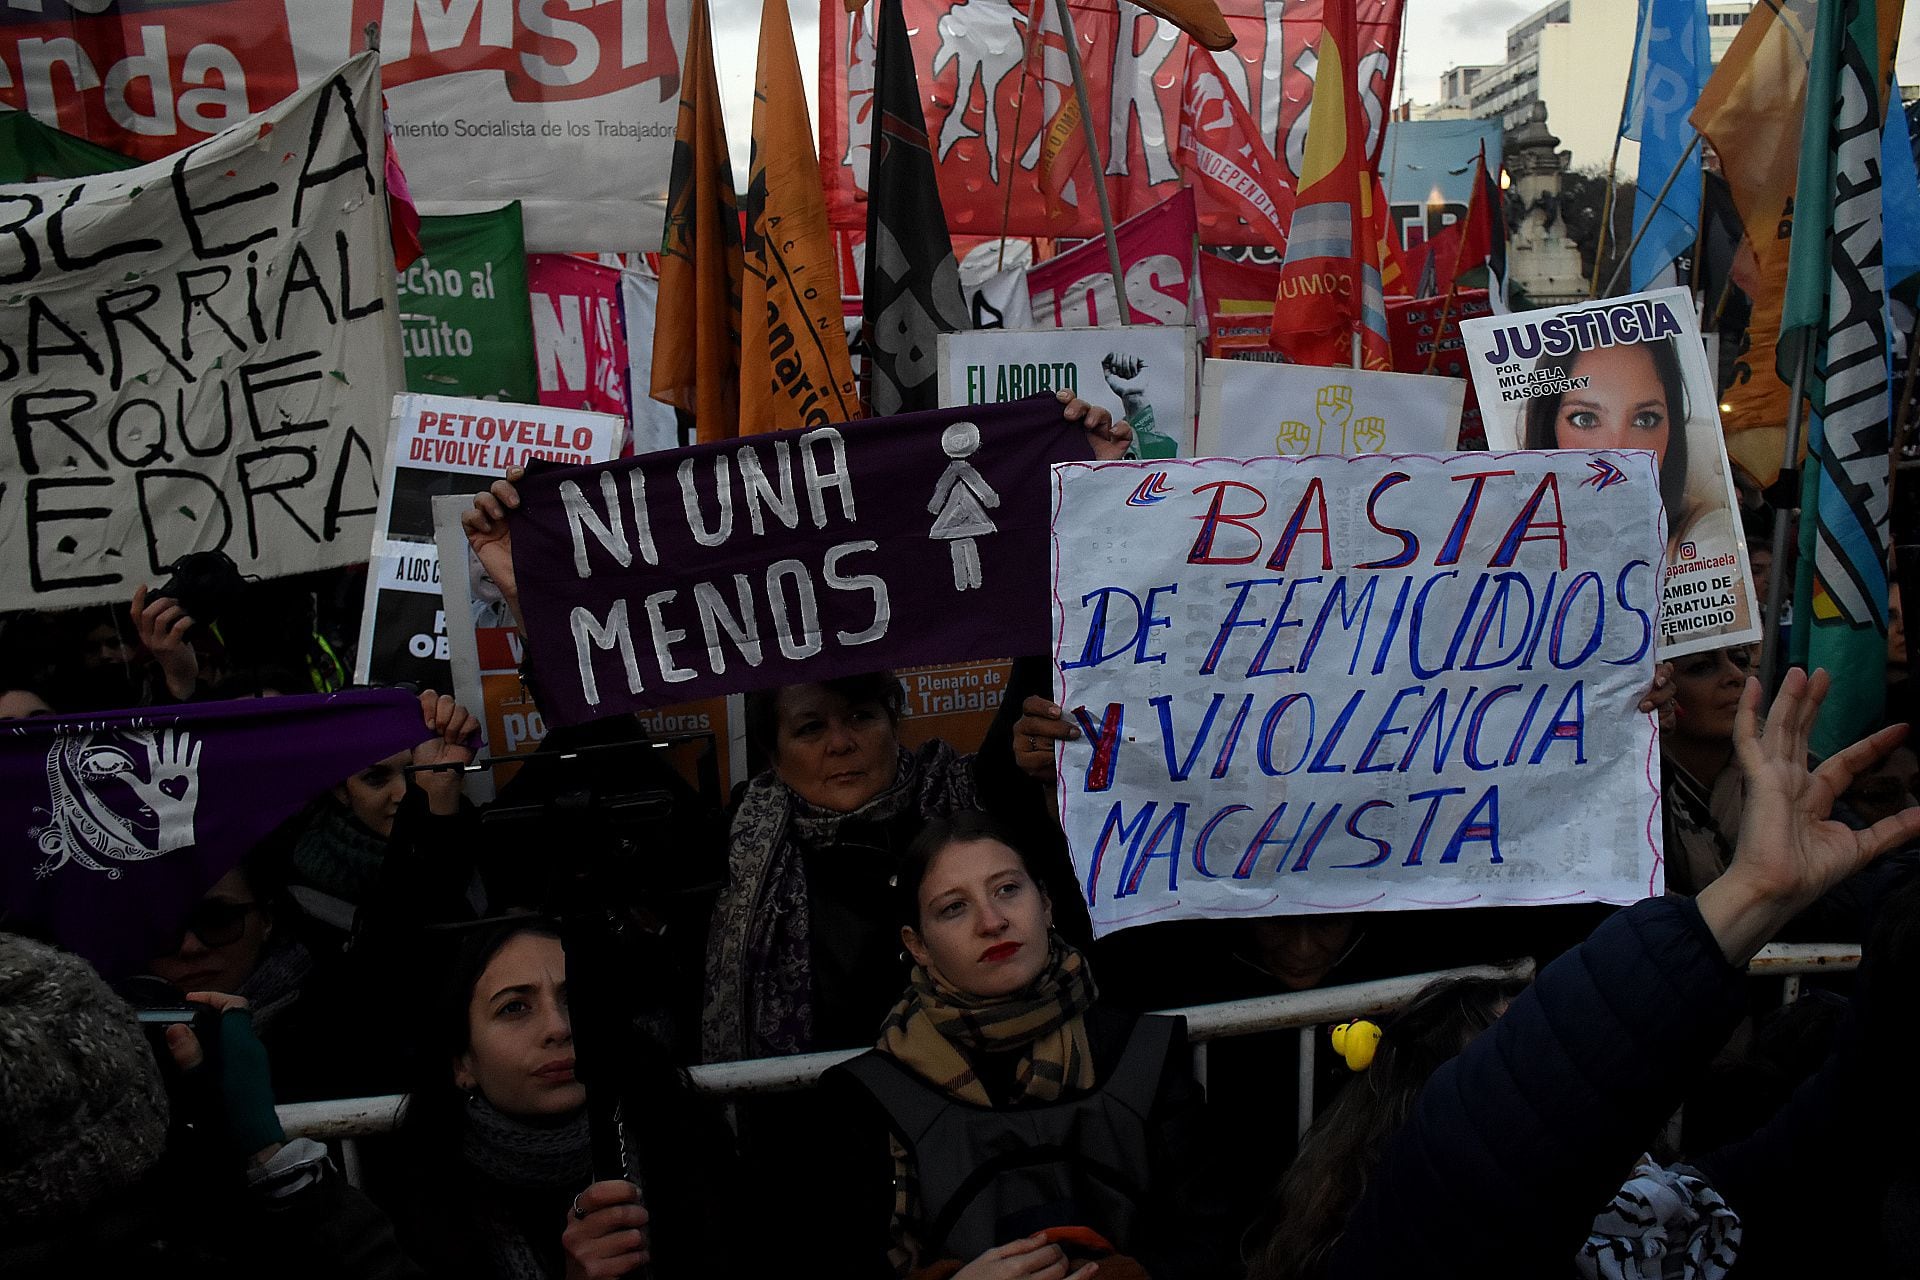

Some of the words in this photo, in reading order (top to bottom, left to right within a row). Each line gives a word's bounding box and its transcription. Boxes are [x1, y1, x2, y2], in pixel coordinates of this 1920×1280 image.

[454, 119, 536, 138] Socialista
[541, 120, 562, 137] de
[567, 120, 590, 137] los
[470, 262, 495, 299] al
[1485, 303, 1683, 364] JUSTICIA
[996, 362, 1078, 403] ABORTO
[1496, 363, 1521, 375] POR
[1498, 367, 1566, 388] MICAELA
[1502, 377, 1590, 401] RASCOVSKY
[418, 411, 593, 451] PETOVELLO
[493, 446, 514, 470] LA
[559, 467, 658, 578] NI
[677, 428, 857, 546] UNA
[1187, 471, 1569, 572] BASTA
[396, 556, 404, 580] A
[407, 557, 430, 581] LOS
[1711, 576, 1731, 590] DE
[570, 540, 891, 706] MENOS
[1060, 583, 1178, 671] DE
[1199, 560, 1652, 681] FEMICIDIOS
[1661, 594, 1734, 618] ARATULA:
[918, 671, 979, 692] Plenario
[984, 669, 1001, 685] de
[1071, 702, 1124, 792] Y
[1149, 680, 1588, 782] VIOLENCIA
[1087, 785, 1504, 907] MACHISTA
